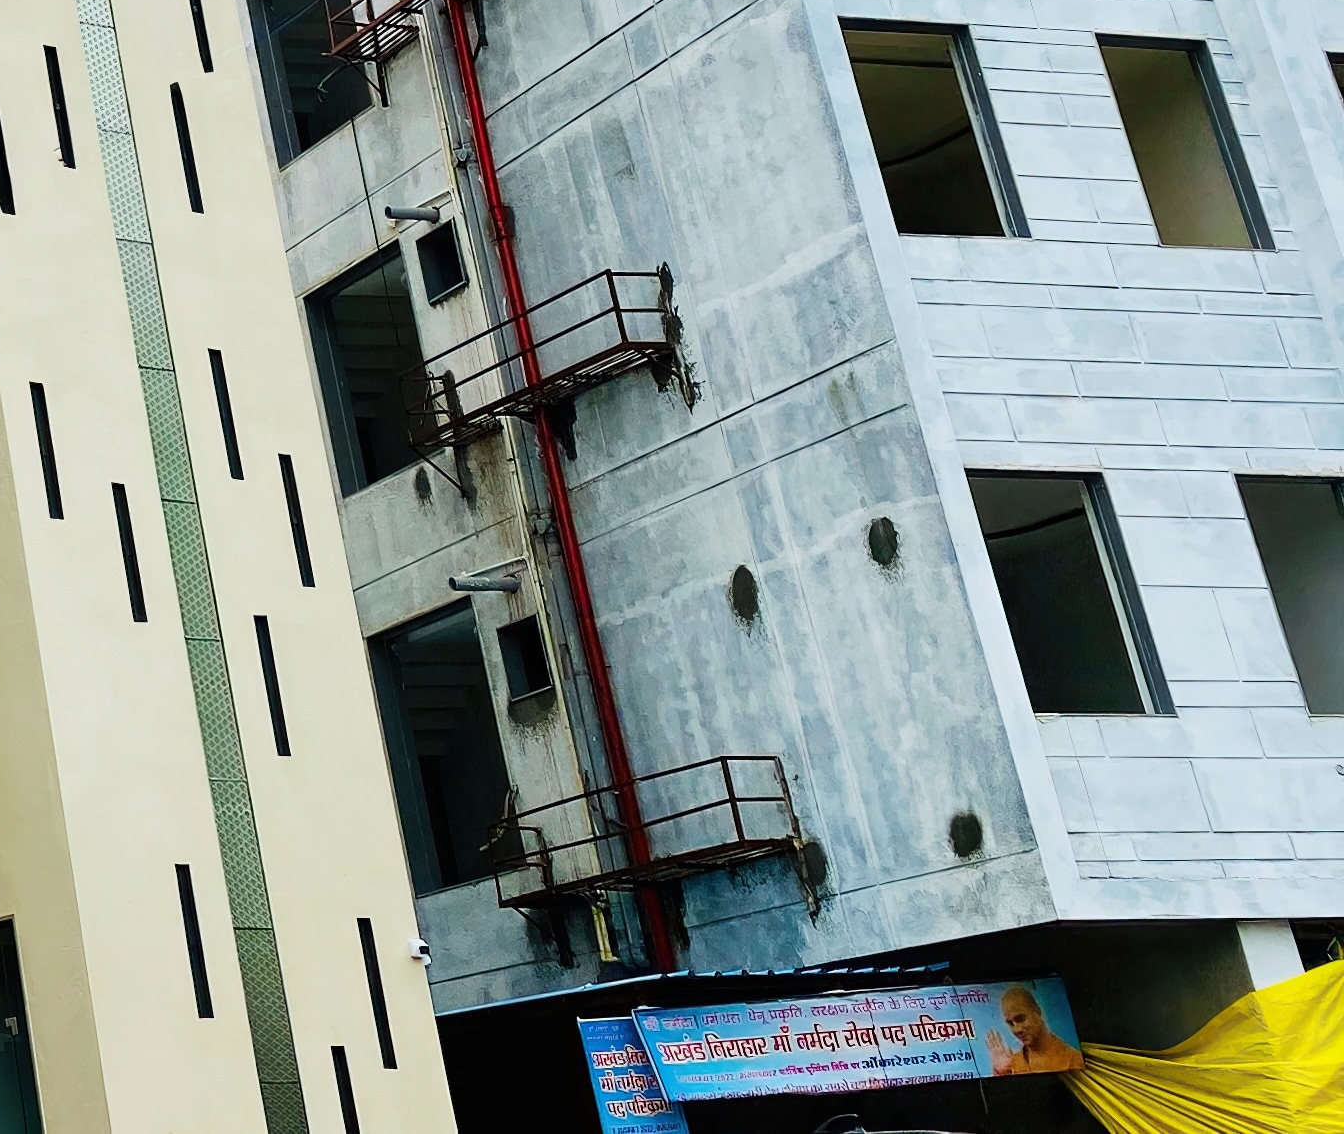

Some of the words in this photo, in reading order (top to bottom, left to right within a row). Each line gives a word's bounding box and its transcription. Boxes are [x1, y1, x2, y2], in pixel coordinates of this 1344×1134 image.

[657, 1033, 706, 1061] अखंड
[706, 1033, 768, 1058] निराहार
[794, 1024, 840, 1052] नर्मदा
[880, 1025, 906, 1046] पद
